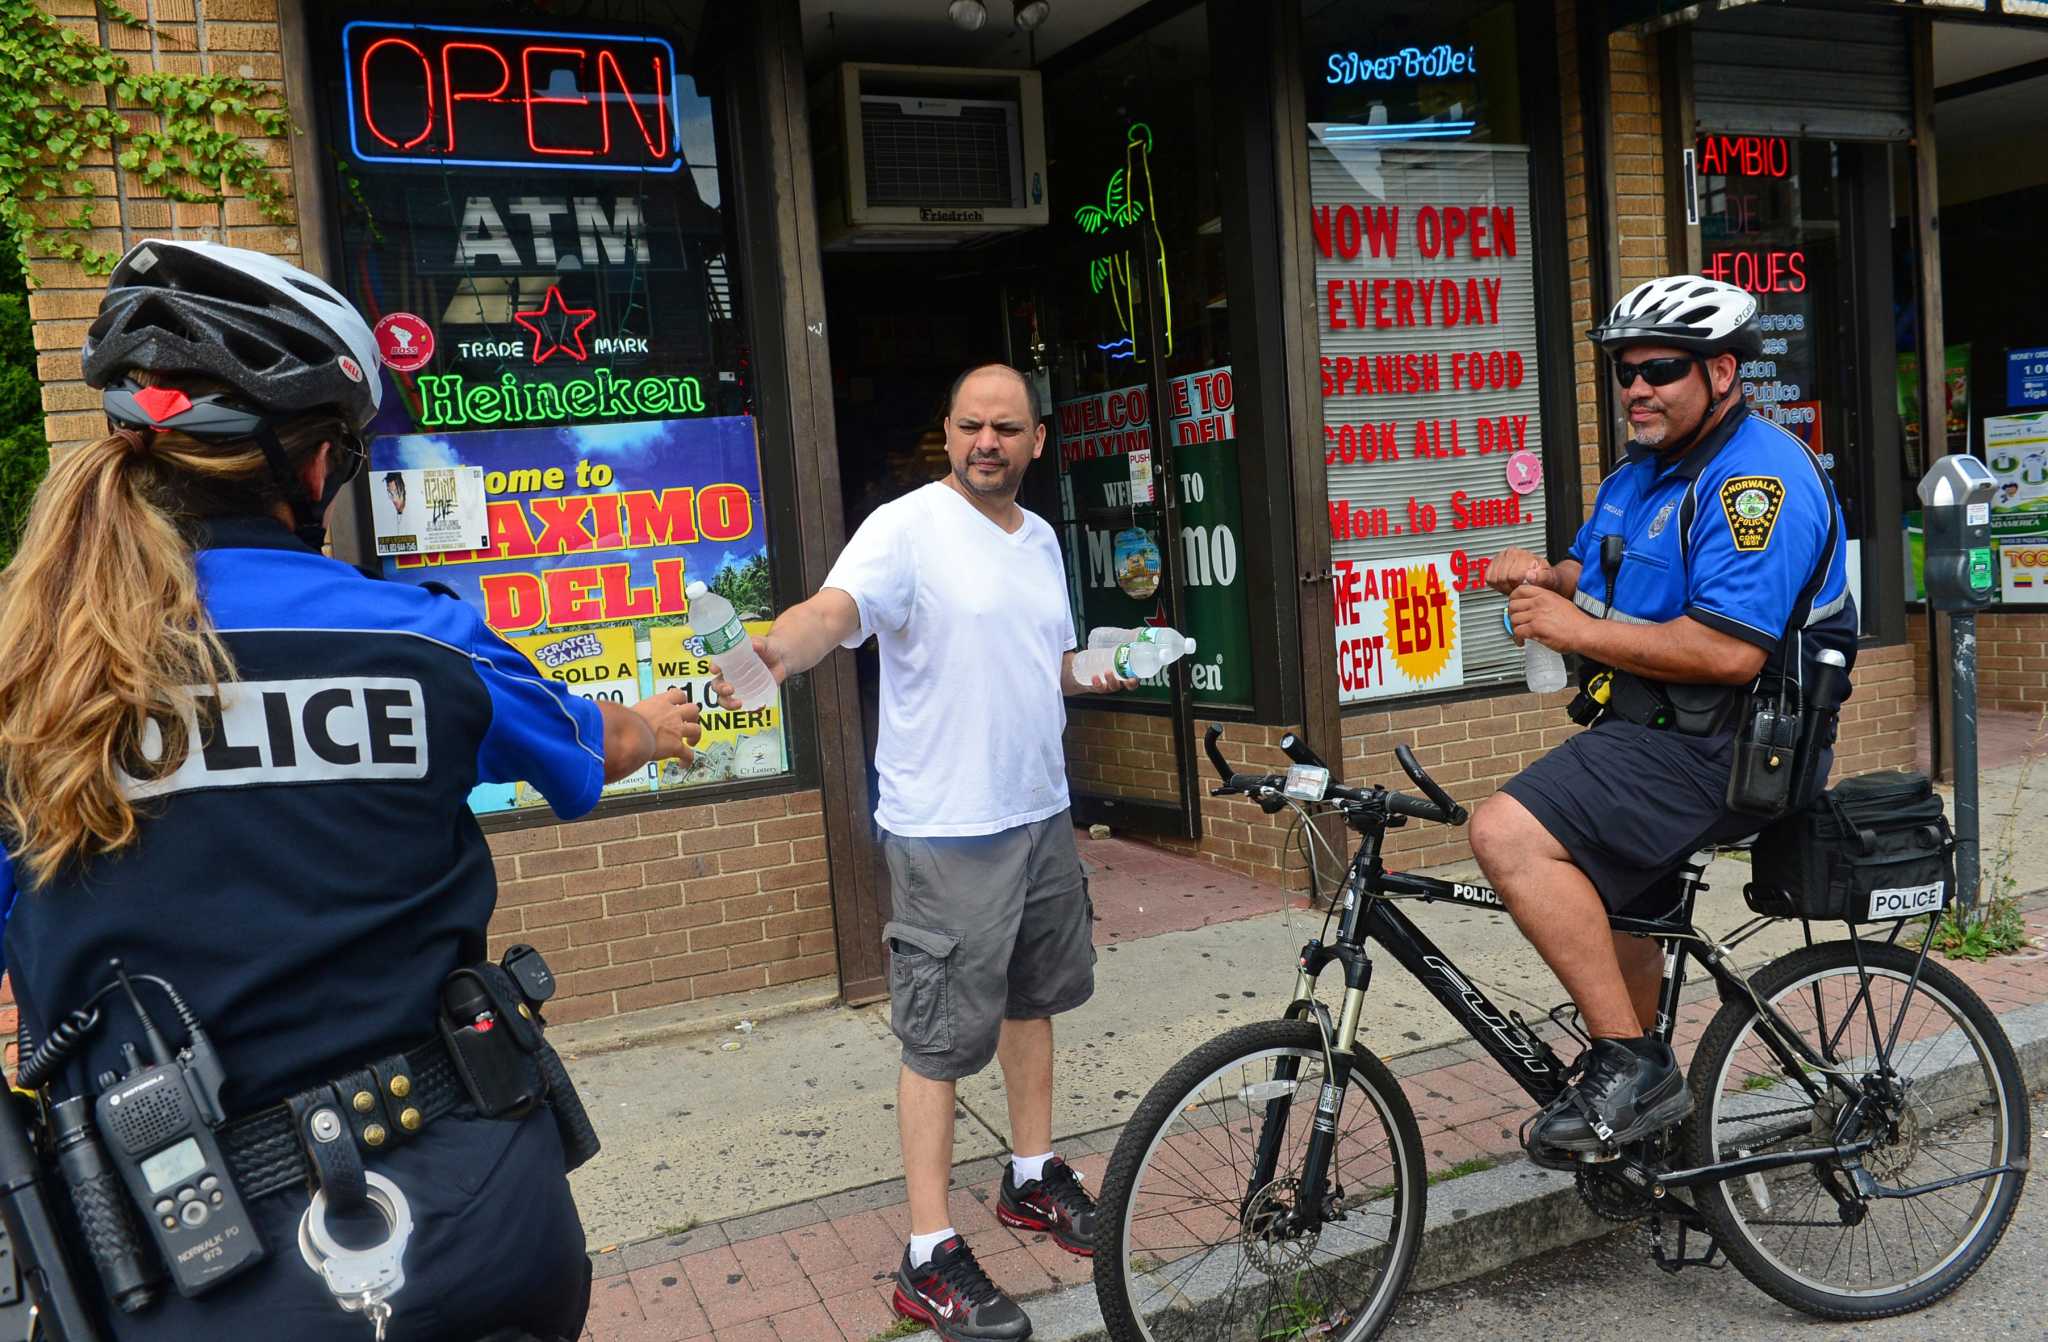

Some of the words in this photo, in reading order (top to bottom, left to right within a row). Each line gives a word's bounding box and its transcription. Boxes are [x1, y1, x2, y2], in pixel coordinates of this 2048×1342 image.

[362, 38, 666, 158] OPEN
[1697, 134, 1788, 178] AMBIO
[919, 208, 983, 222] Friedrich
[454, 197, 651, 265] ATM
[1311, 204, 1399, 260] NOW
[1416, 205, 1517, 259] OPEN
[1702, 251, 1807, 293] HEQUES
[1327, 278, 1502, 330] EVERYDAY
[1757, 312, 1804, 331] ereos
[458, 341, 524, 359] TRADE
[595, 337, 649, 354] MARK
[342, 358, 361, 379] BELL
[1320, 353, 1440, 398] SPANISH
[1451, 350, 1525, 391] FOOD
[417, 367, 706, 426] Heineken
[1194, 370, 1234, 415] TO
[1743, 381, 1800, 401] Publico
[1764, 403, 1816, 425] Dinero
[1324, 421, 1400, 466] COOK
[1414, 418, 1466, 460] ALL
[1477, 415, 1528, 456] DAY
[1130, 453, 1150, 464] PUSH
[575, 459, 614, 487] to
[1728, 479, 1777, 493] NORWALK
[1180, 472, 1205, 504] TO
[395, 482, 753, 569] AXIMO
[1329, 499, 1404, 541] Mon.
[1408, 496, 1437, 534] to
[1451, 490, 1533, 532] Sund.
[1737, 516, 1766, 526] POLICE
[480, 557, 689, 633] DELI
[1394, 592, 1448, 656] EBT
[536, 633, 595, 660] SCRATCH
[546, 643, 602, 668] GAMES
[552, 665, 610, 684] SOLD
[618, 663, 632, 678] A
[658, 661, 690, 677] WE
[1338, 635, 1384, 693] CEPT
[112, 687, 417, 781] OLICE
[699, 709, 772, 732] NNER!
[752, 766, 777, 775] Lottery
[1875, 889, 1937, 912] POLICE
[122, 1074, 165, 1099] MOTOROLA
[177, 1235, 224, 1264] NORWALK
